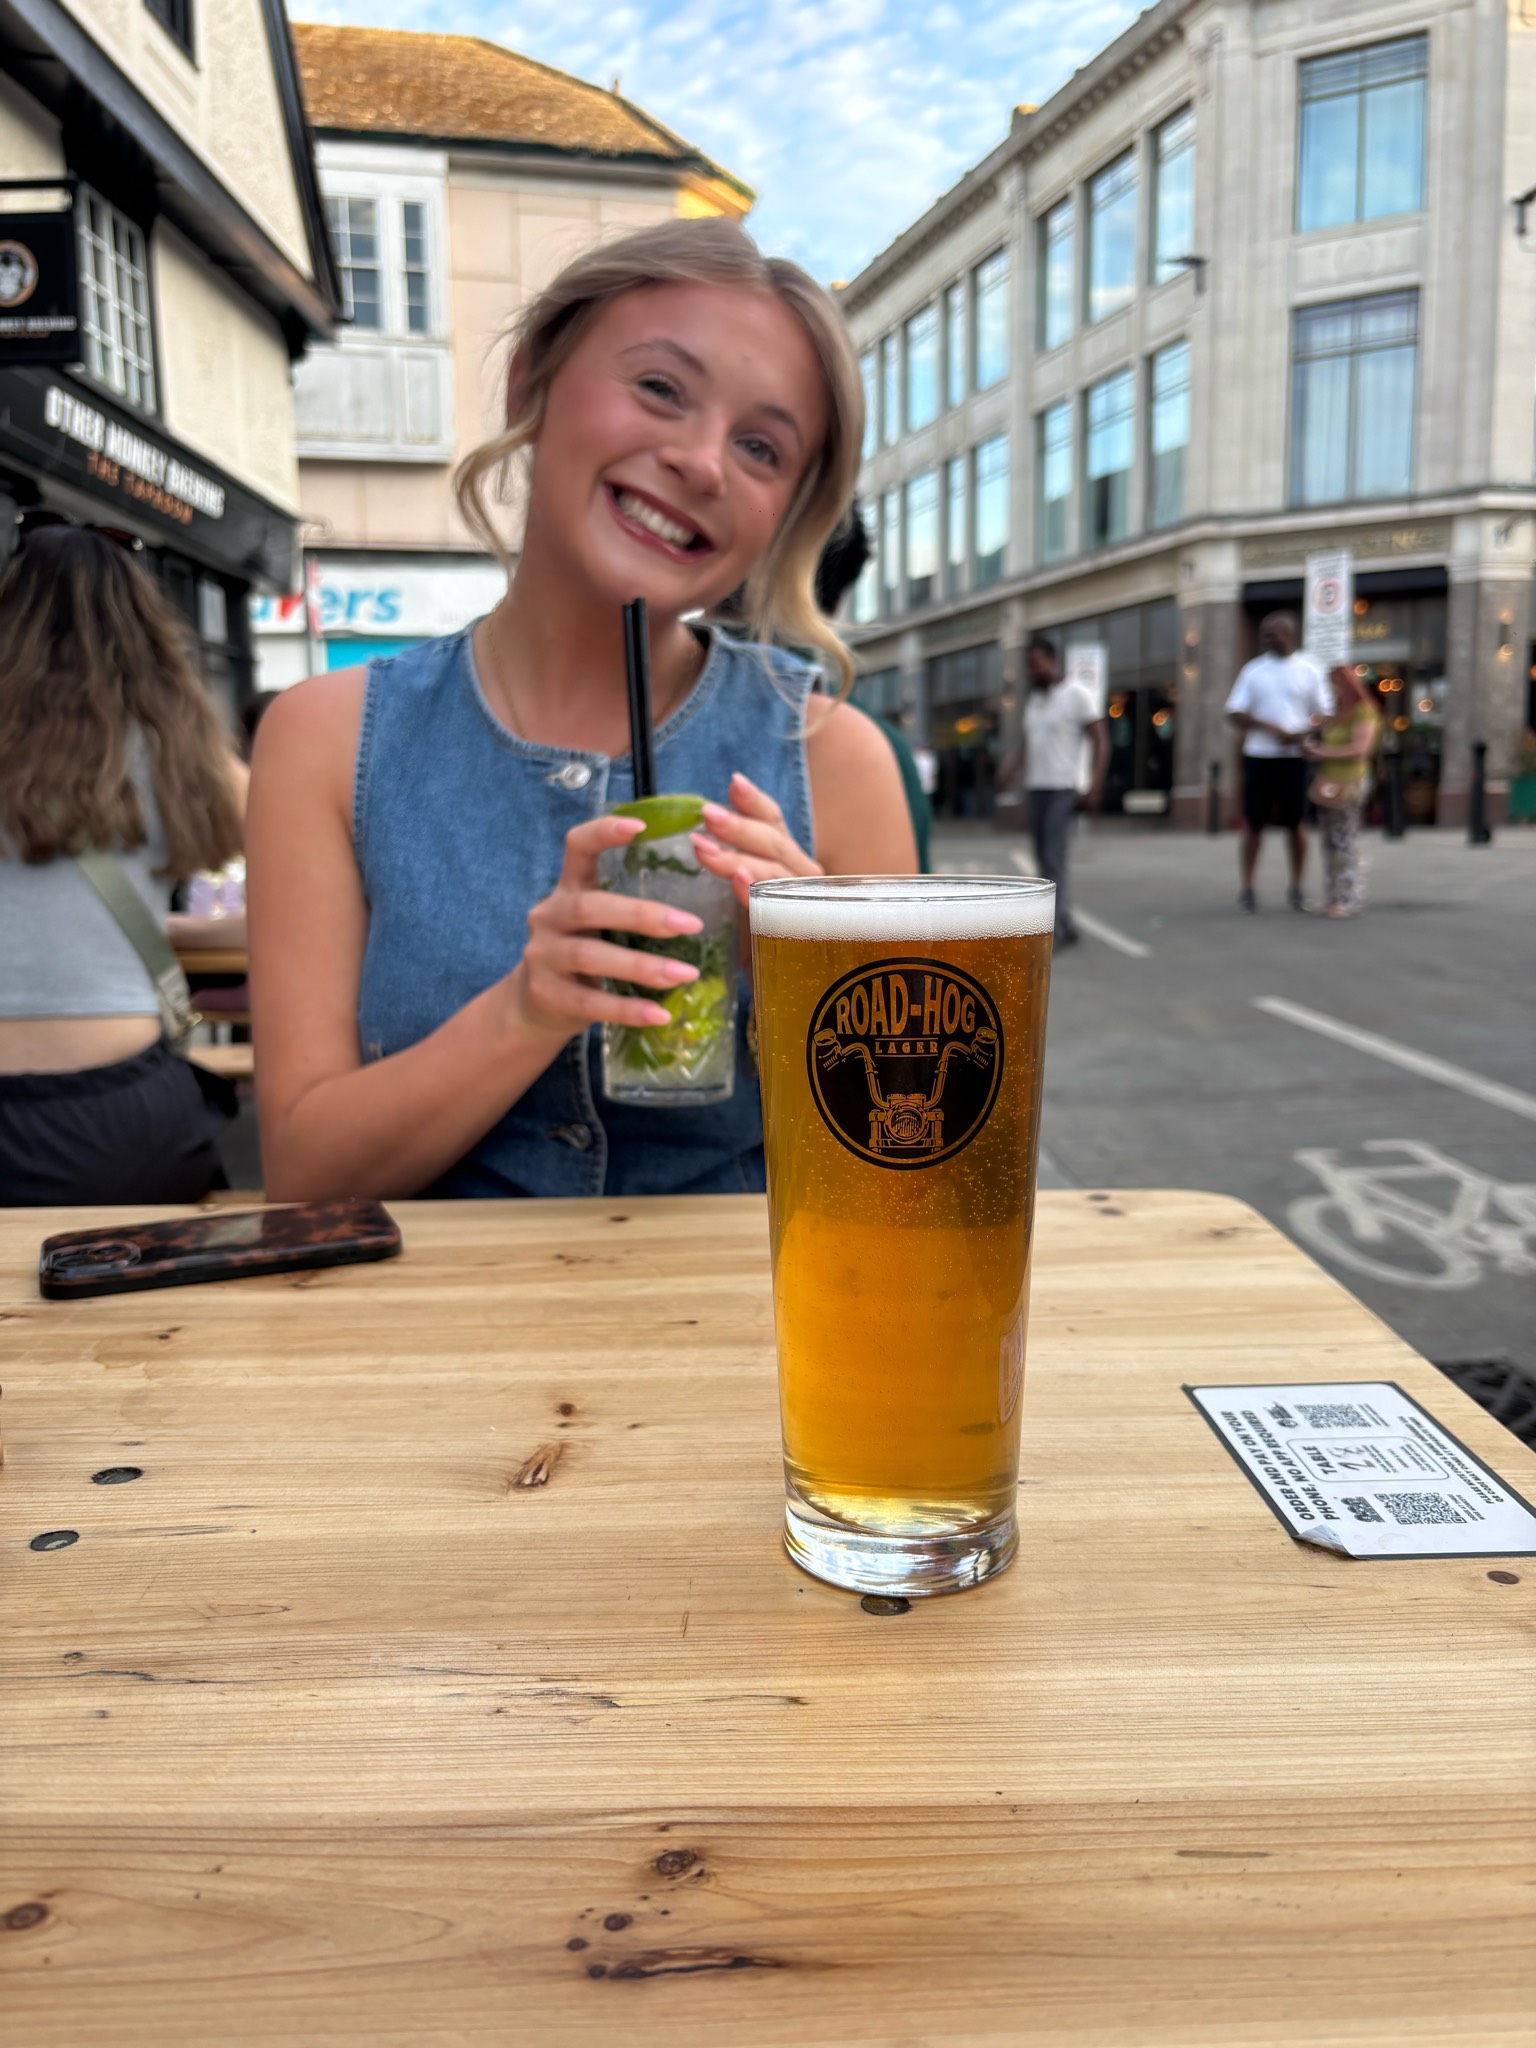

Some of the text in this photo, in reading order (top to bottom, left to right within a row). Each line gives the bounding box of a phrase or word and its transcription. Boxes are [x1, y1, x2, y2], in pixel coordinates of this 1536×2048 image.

[253, 587, 403, 622] vers
[835, 974, 976, 1036] ROAD-HOG
[874, 1040, 939, 1054] LAGER
[1239, 1410, 1281, 1447] REQUIRED
[1220, 1411, 1316, 1520] ORDER AND PAY ON YOUR
[1270, 1449, 1297, 1466] APP
[1302, 1446, 1338, 1474] TABLE
[1285, 1468, 1309, 1481] NO
[1297, 1483, 1340, 1520] PHONE,
[1470, 1486, 1494, 1503] PLEASE
